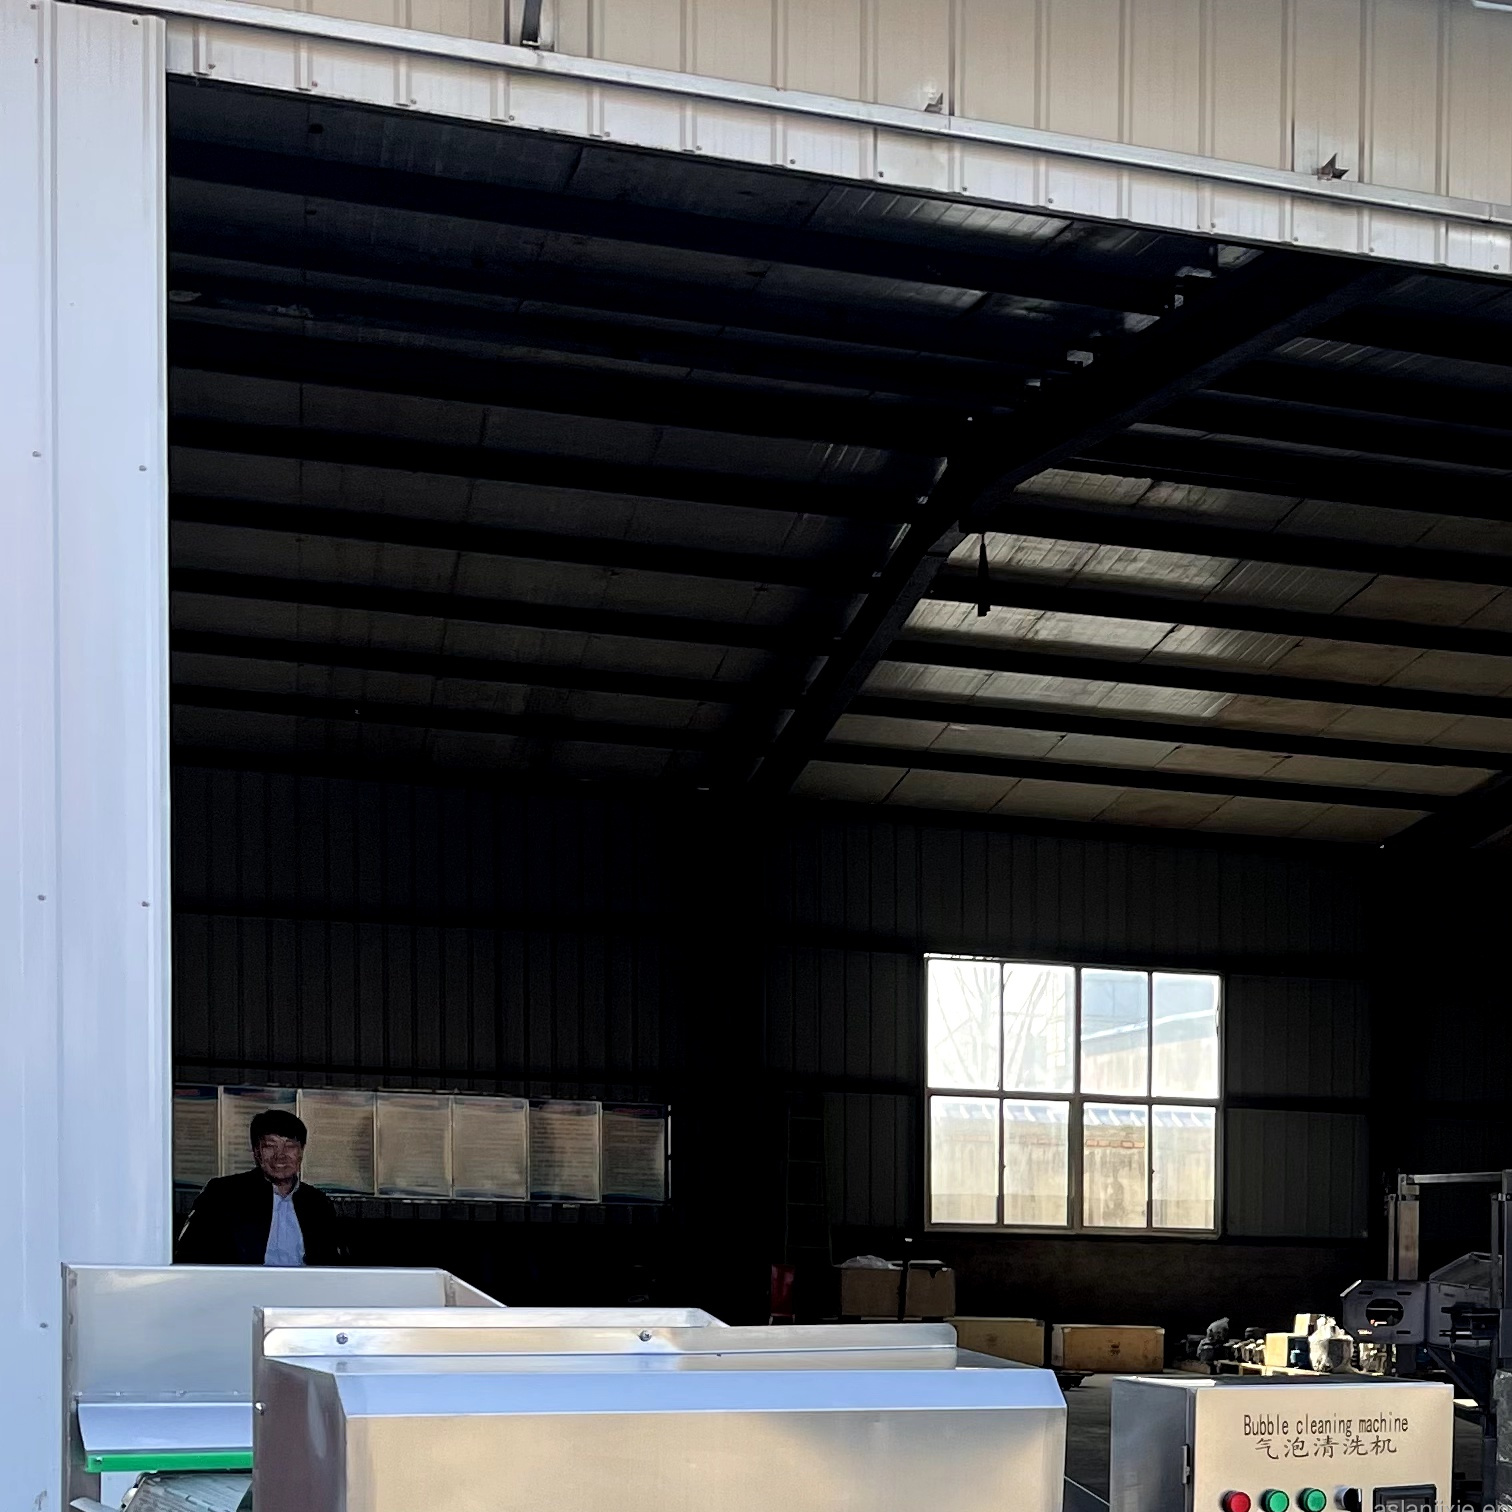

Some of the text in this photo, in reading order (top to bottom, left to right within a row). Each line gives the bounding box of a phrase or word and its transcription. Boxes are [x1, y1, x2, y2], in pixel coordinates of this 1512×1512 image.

[1243, 1411, 1408, 1437] Bubble cleaning machine
[1255, 1435, 1398, 1460] 气泡清洗机
